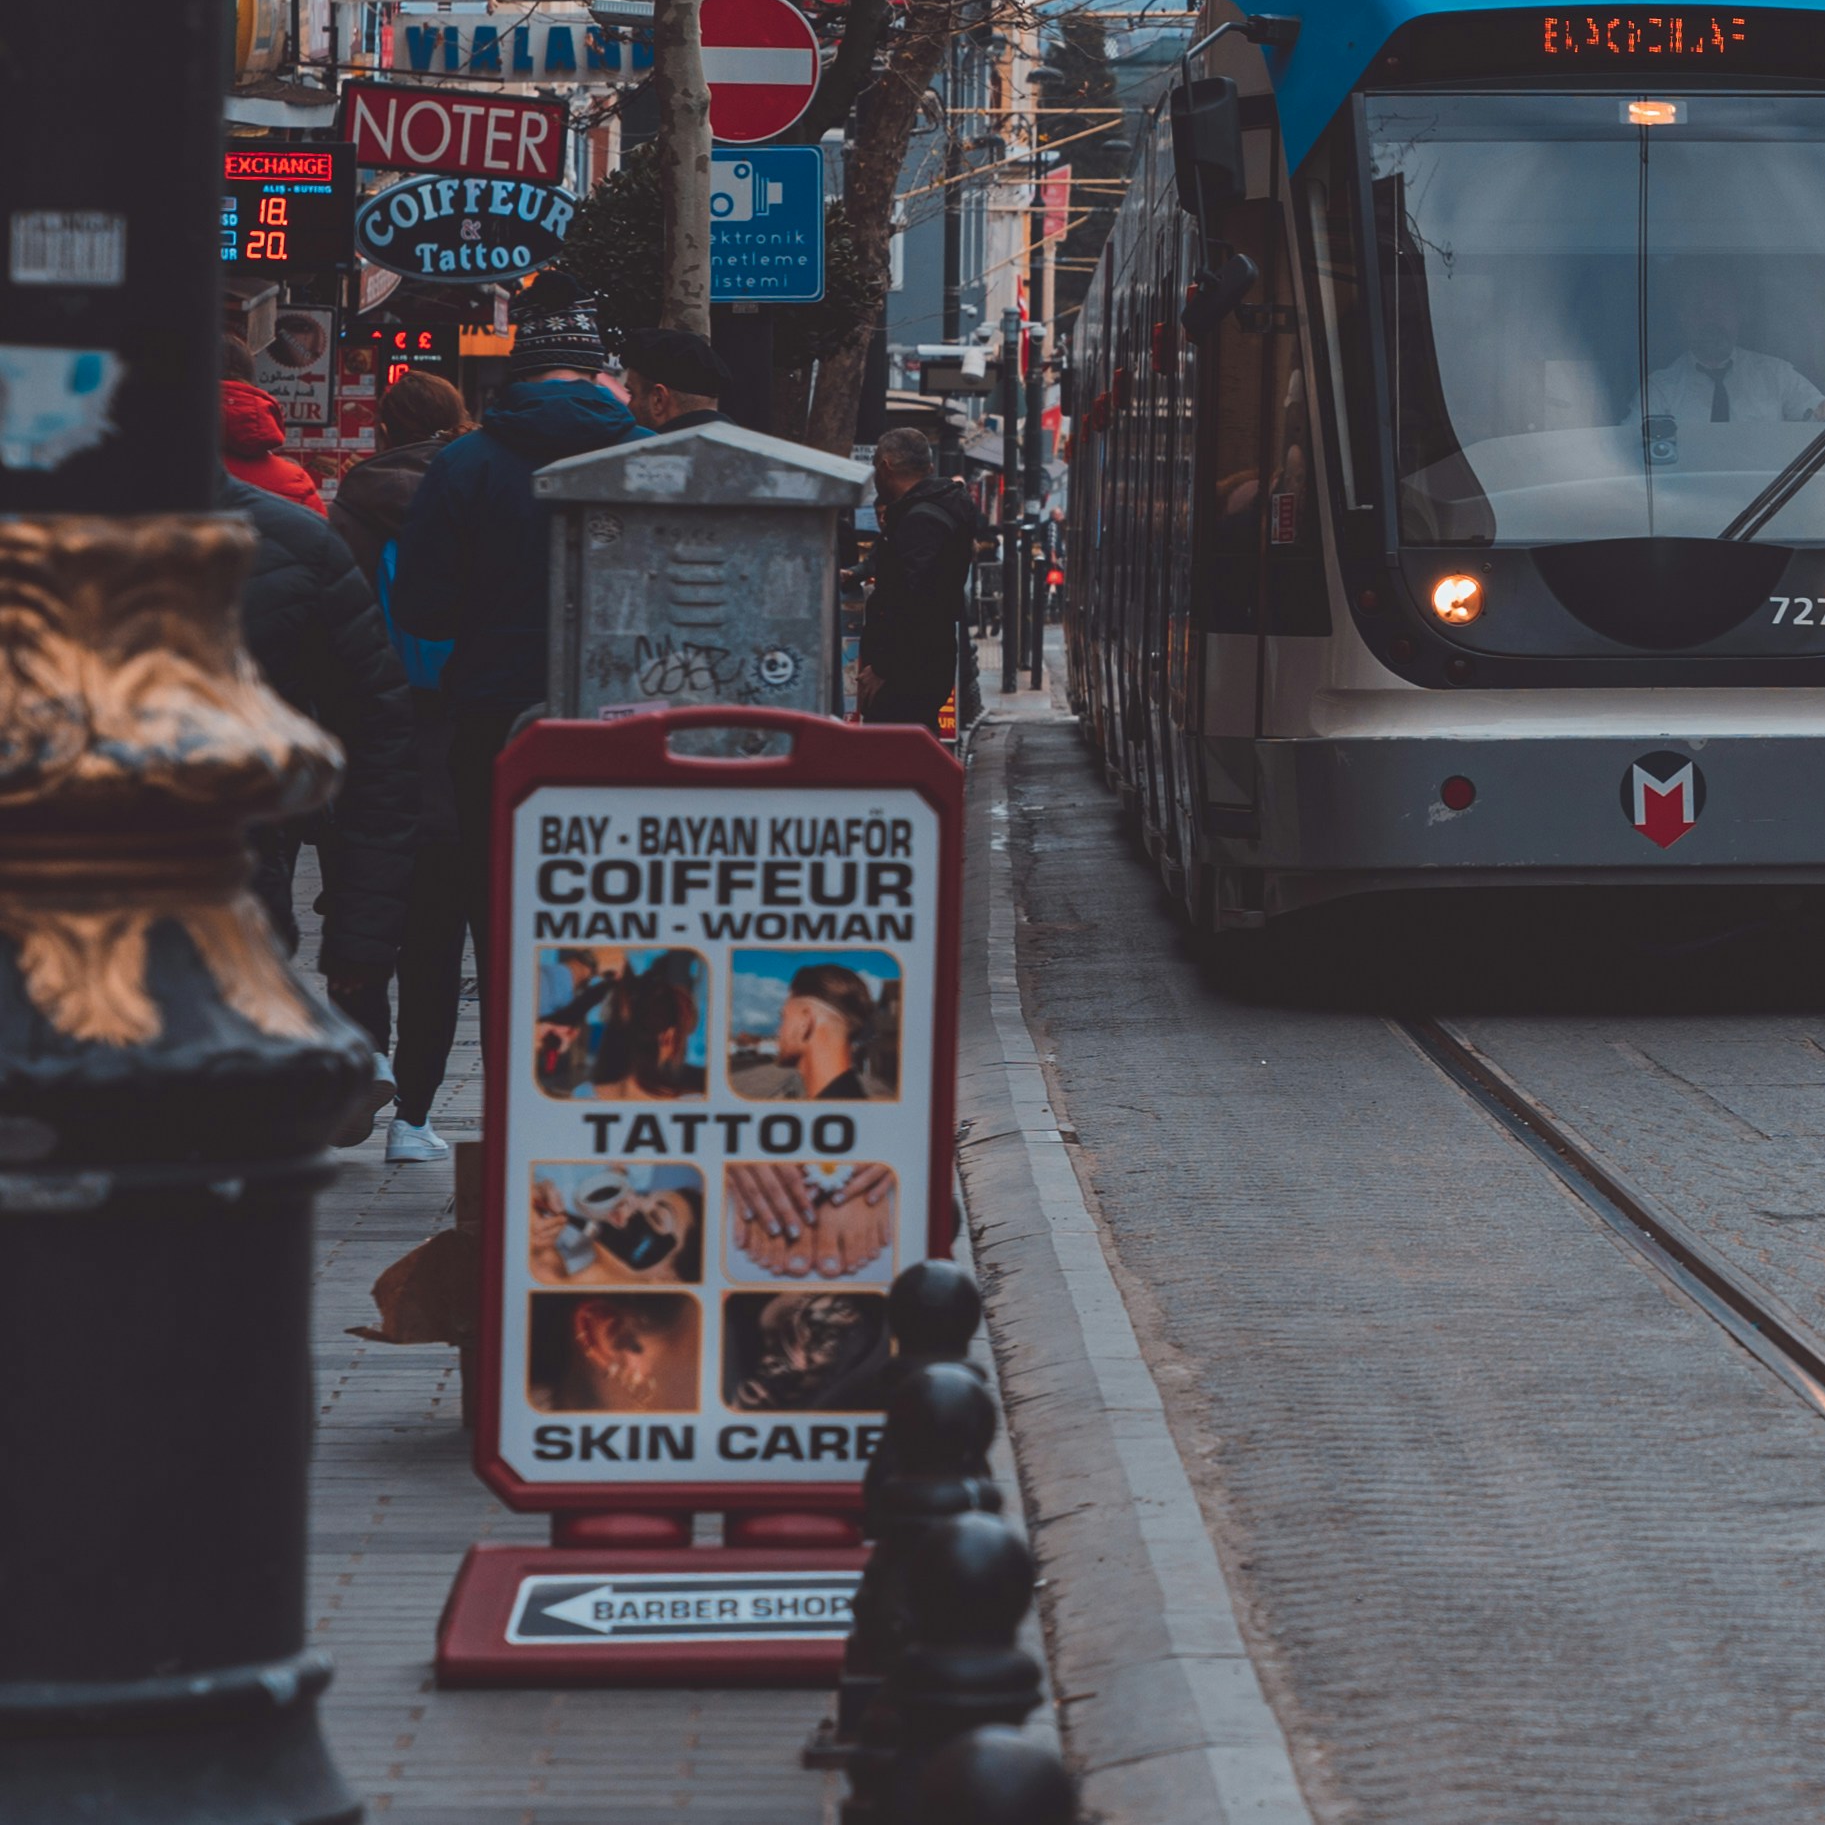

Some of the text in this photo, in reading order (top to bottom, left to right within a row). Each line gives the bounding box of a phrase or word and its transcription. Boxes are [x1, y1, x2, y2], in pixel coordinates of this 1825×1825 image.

[353, 94, 548, 174] NOTER
[226, 157, 330, 175] EXCHANGE
[293, 185, 332, 194] BUYING
[364, 178, 576, 247] COIFFEUR
[415, 243, 532, 273] Tattoo
[539, 816, 611, 856] BAY
[638, 816, 757, 857] BAYAN
[768, 807, 913, 858] KUAFÖR
[536, 859, 914, 907] COIFFEUR
[534, 911, 658, 940] MAN
[700, 912, 914, 941] WOMAN
[583, 1114, 856, 1155] TATTOO
[533, 1425, 695, 1462] SKIN
[592, 1594, 853, 1622] BARBER SHOP
